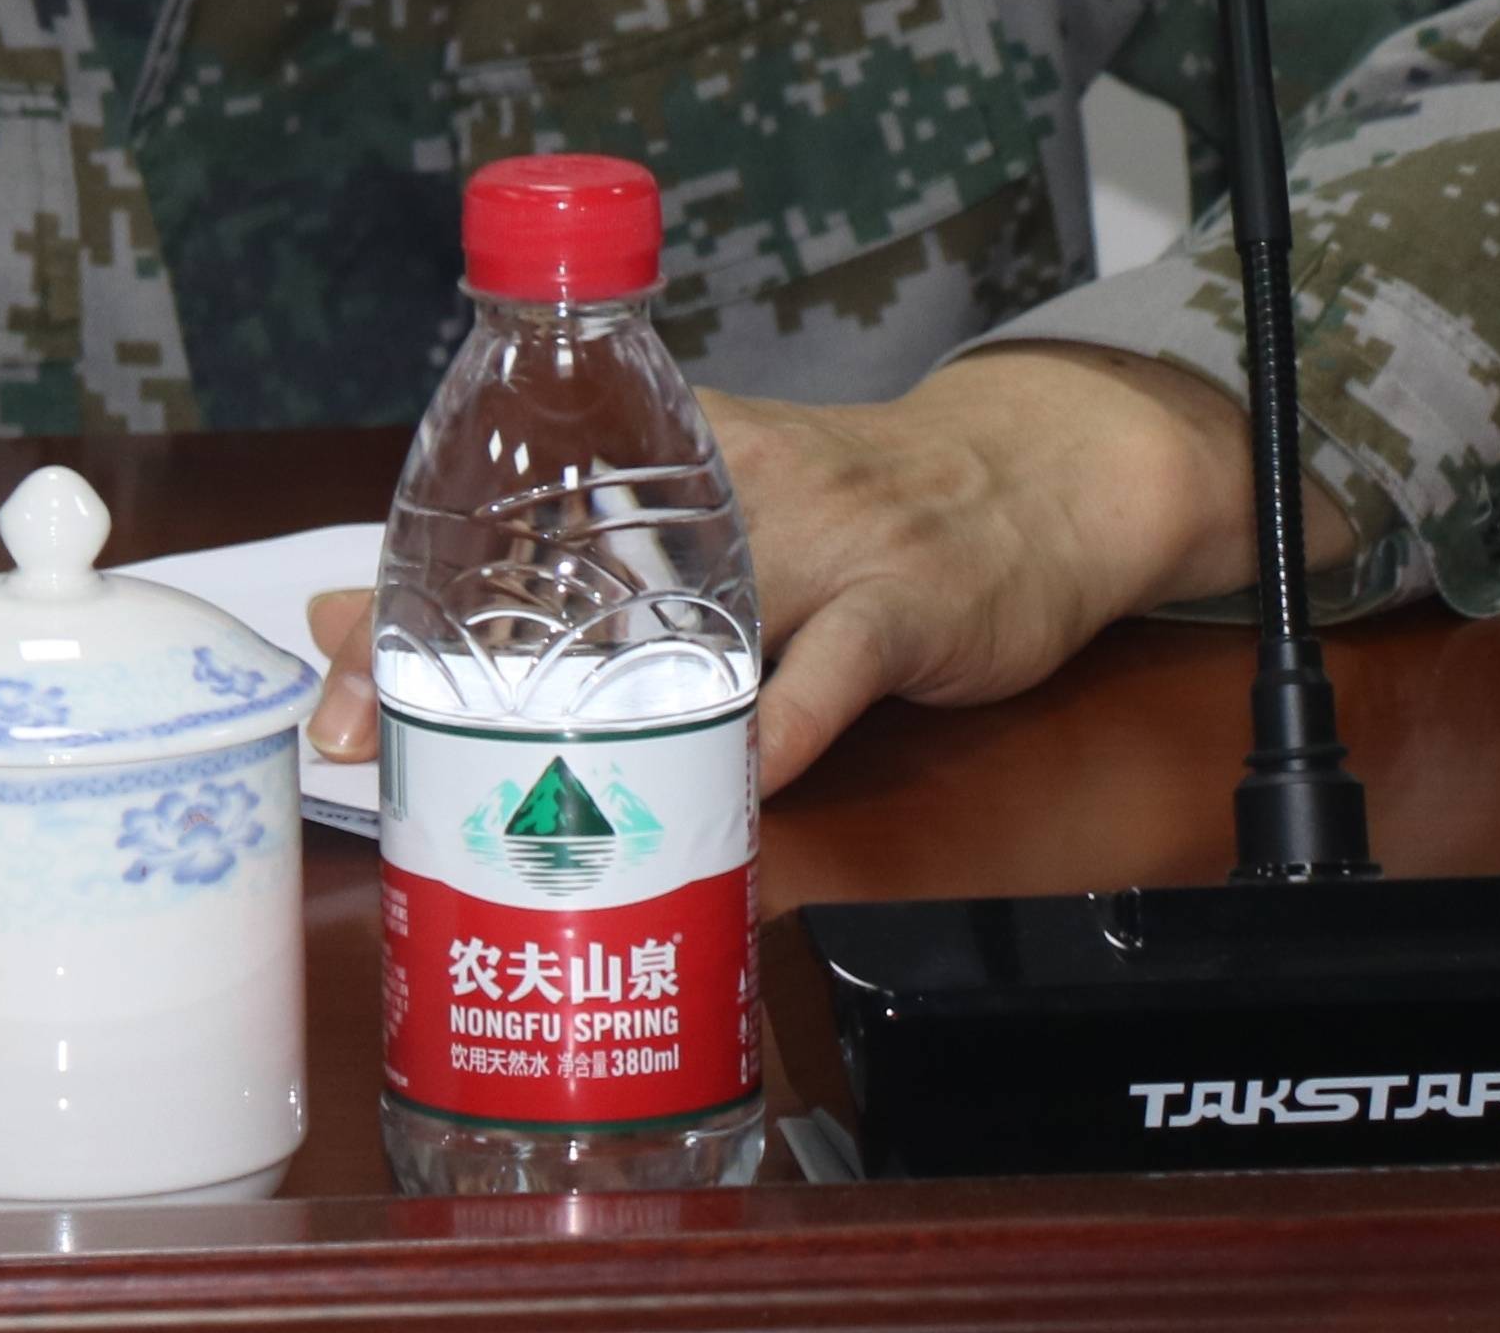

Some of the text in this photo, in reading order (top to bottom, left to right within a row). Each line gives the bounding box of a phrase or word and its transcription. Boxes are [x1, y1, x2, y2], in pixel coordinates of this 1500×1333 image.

[447, 937, 680, 1006] 农夫山泉
[450, 1005, 680, 1043] NONGFU SPRING
[450, 1044, 550, 1078] 饮用天然水
